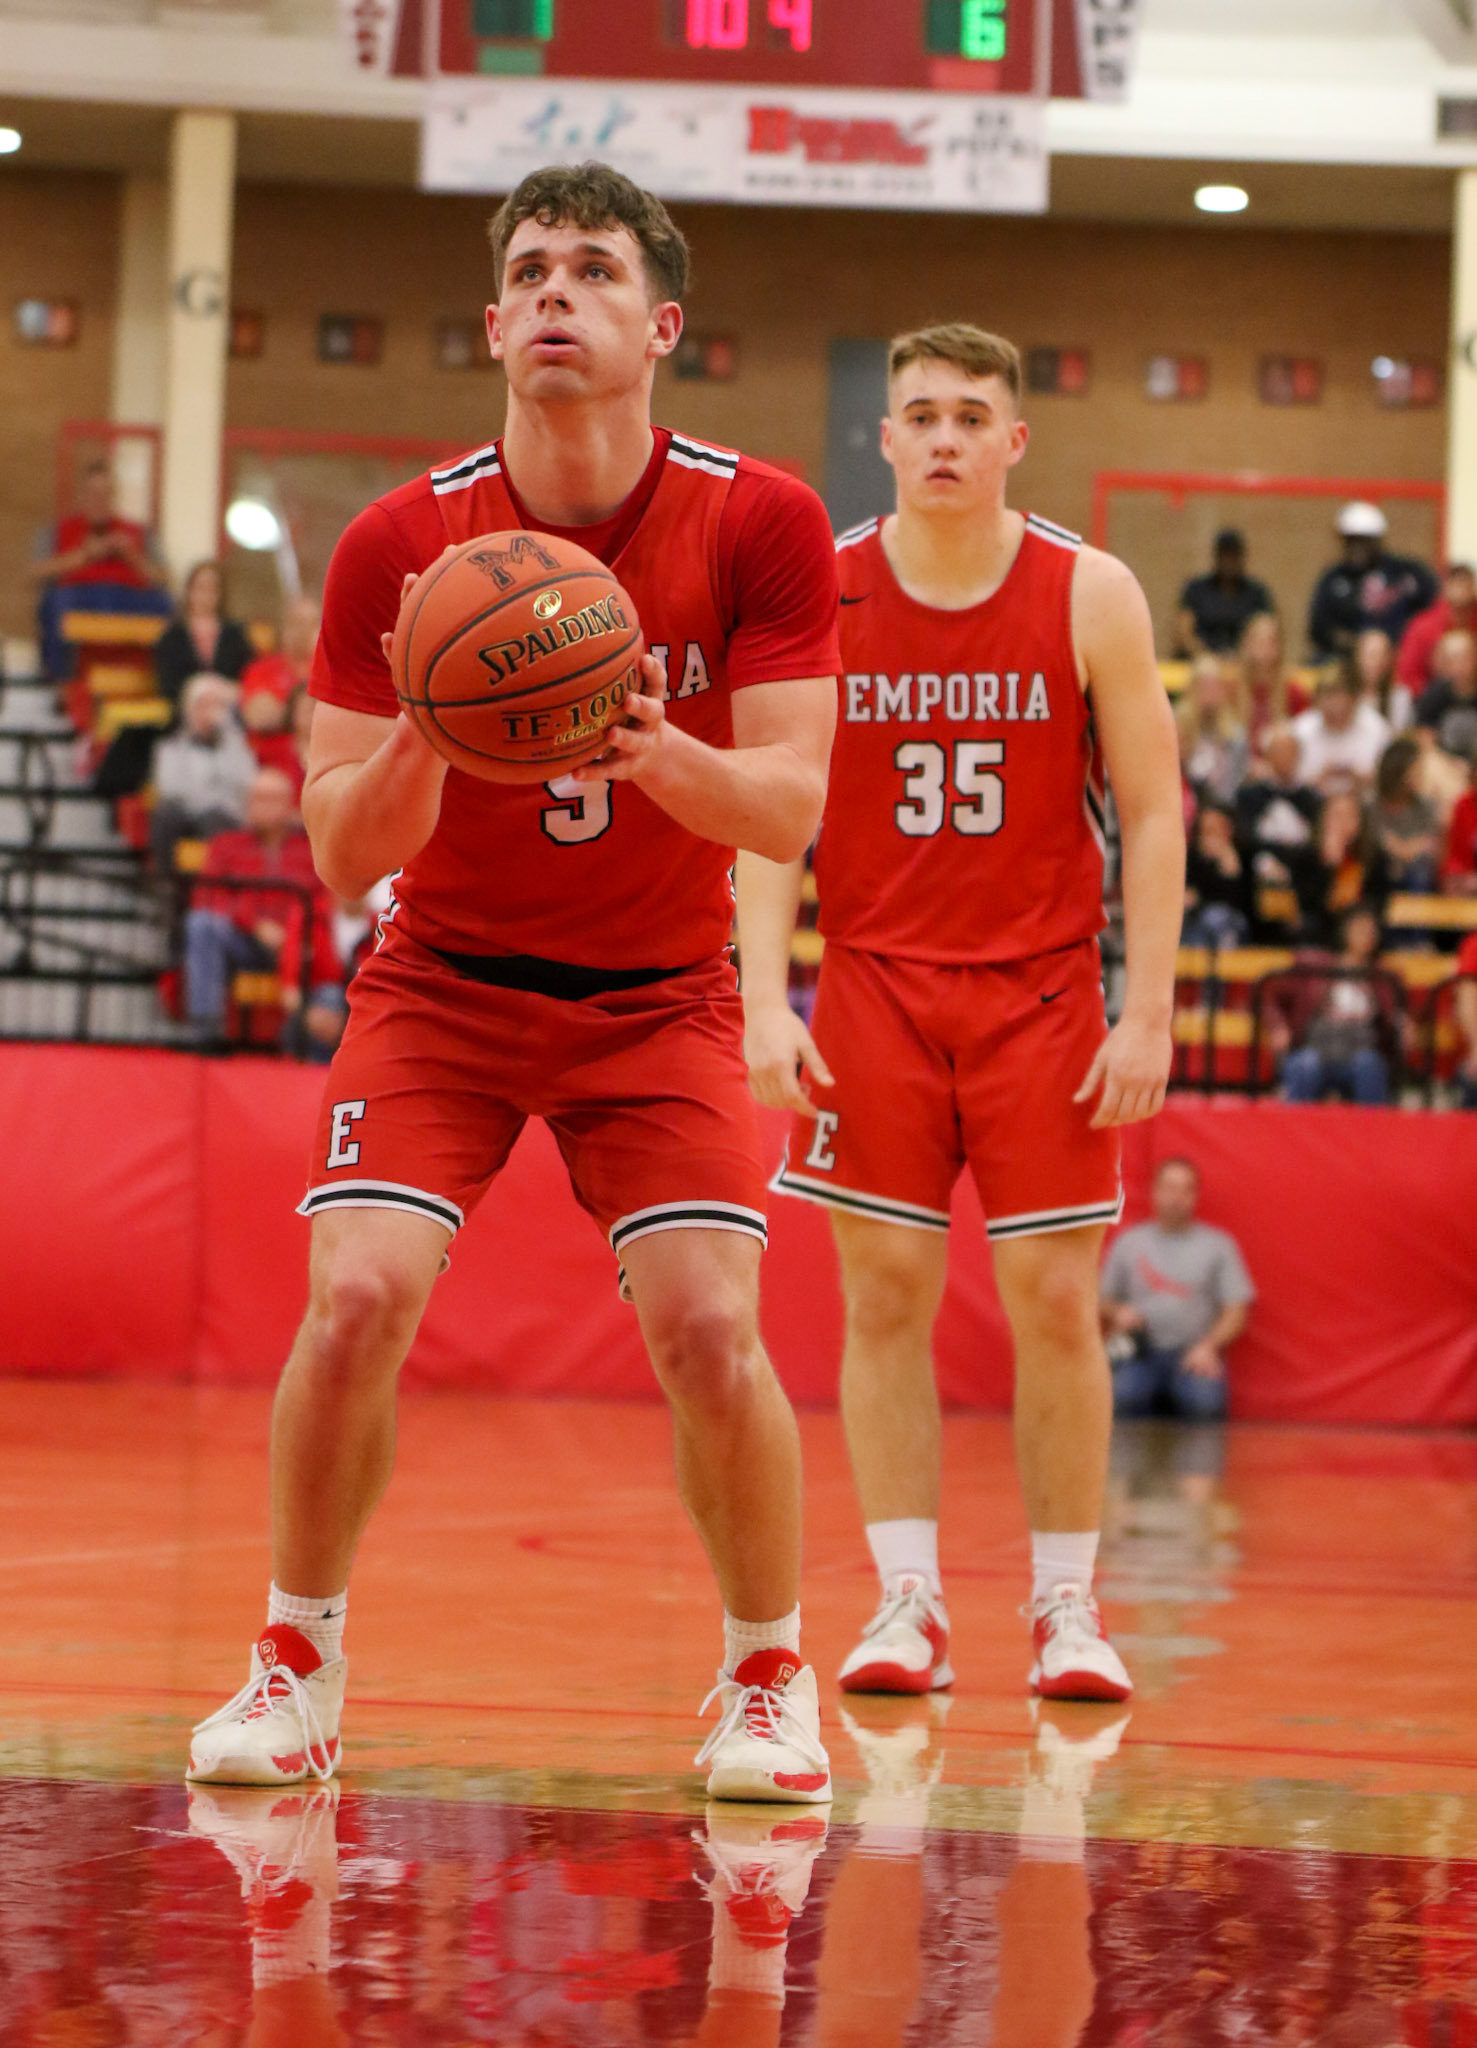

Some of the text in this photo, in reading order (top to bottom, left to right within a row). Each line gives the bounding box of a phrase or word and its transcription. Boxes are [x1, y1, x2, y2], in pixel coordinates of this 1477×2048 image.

[960, 0, 1006, 61] 6
[479, 594, 629, 686] SPALDING
[845, 672, 1051, 723] EMPORIA
[893, 739, 1006, 837] 35
[325, 1098, 368, 1170] E
[804, 1109, 839, 1171] E
